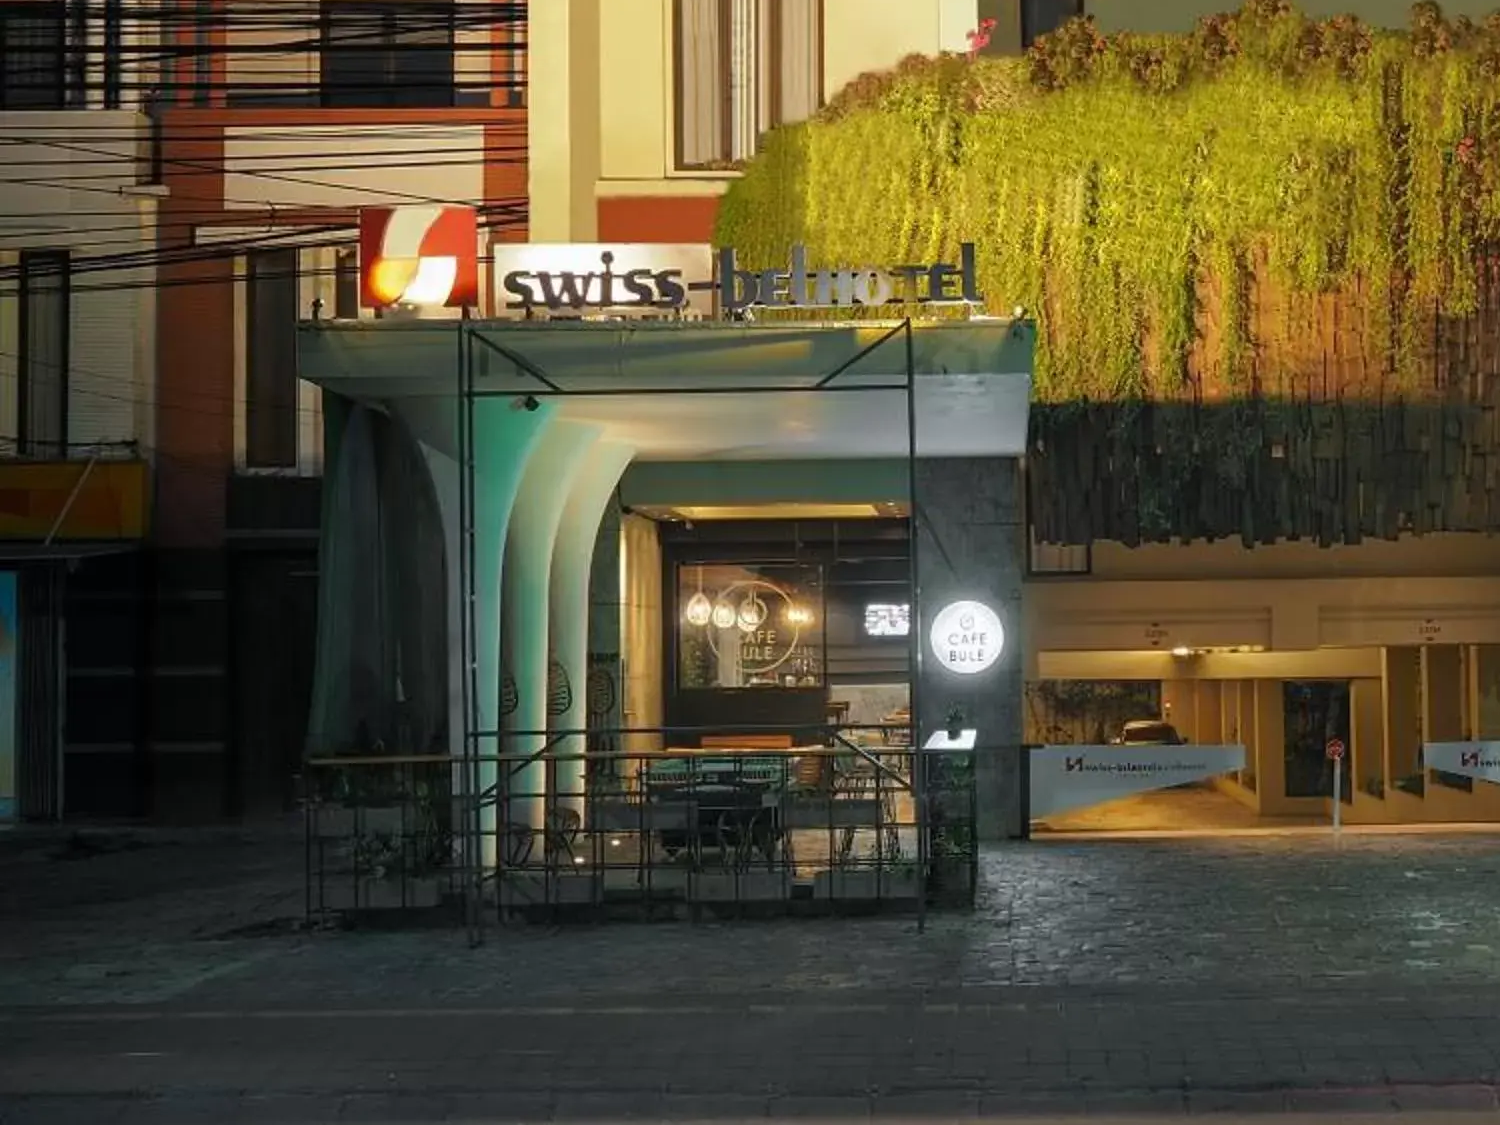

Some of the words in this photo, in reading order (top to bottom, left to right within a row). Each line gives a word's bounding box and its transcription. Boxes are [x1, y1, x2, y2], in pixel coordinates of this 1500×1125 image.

[948, 632, 989, 646] CAFE
[741, 646, 774, 660] ULE
[949, 649, 985, 662] BULE
